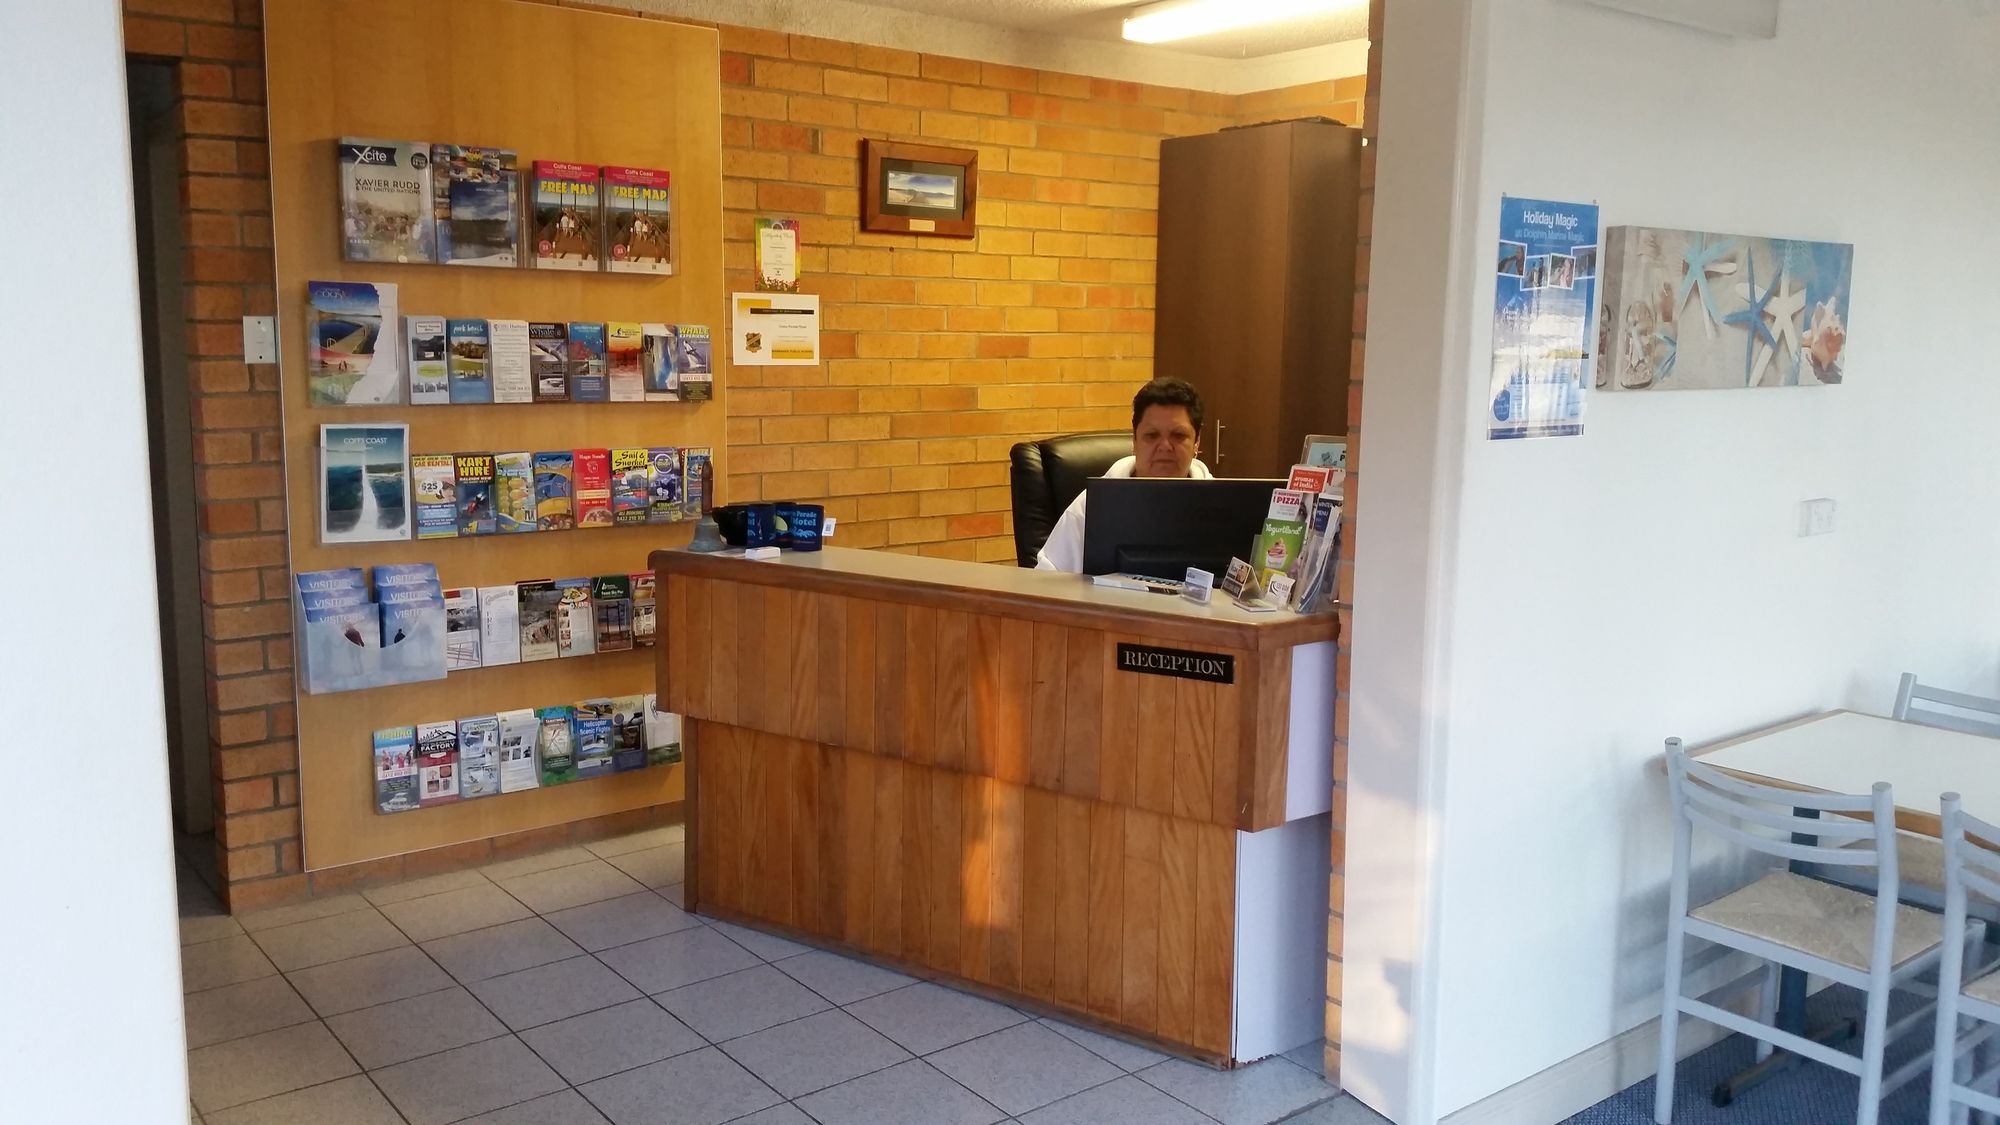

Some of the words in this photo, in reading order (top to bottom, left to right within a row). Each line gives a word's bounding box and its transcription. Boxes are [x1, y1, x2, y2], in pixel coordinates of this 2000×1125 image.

[351, 146, 387, 166] Xcite
[355, 179, 389, 188] XAVIER
[392, 181, 421, 190] RUDD
[540, 180, 568, 193] FREE
[570, 182, 596, 196] MAP
[613, 186, 639, 199] FREE
[642, 188, 668, 201] MAP
[1523, 211, 1554, 229] Holiday
[1555, 213, 1578, 230] Magic
[457, 457, 492, 467] KART
[614, 458, 645, 467] Snorkel
[460, 466, 490, 477] HIRE
[1277, 496, 1300, 506] PIZZA
[792, 518, 816, 526] Motel
[1265, 523, 1303, 536] Yogurtland
[1124, 650, 1226, 676] RECEPTION
[583, 720, 607, 728] Helicopter
[420, 742, 455, 752] FACTORY
